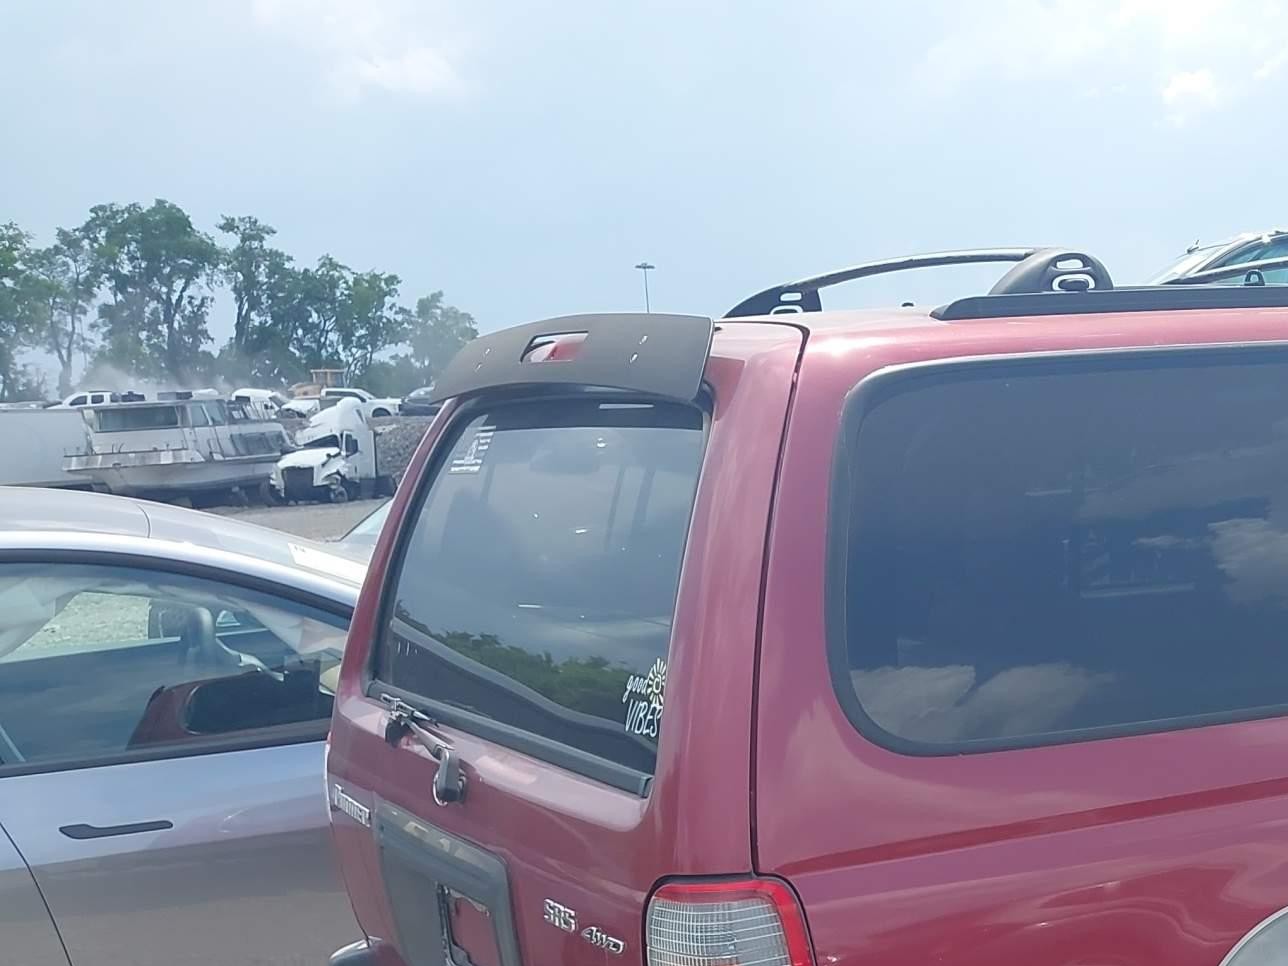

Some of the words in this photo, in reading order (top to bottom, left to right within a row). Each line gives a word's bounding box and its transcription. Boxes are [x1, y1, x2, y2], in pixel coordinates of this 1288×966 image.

[622, 668, 651, 703] good
[625, 698, 663, 738] VIBES
[581, 926, 625, 955] 4WD
